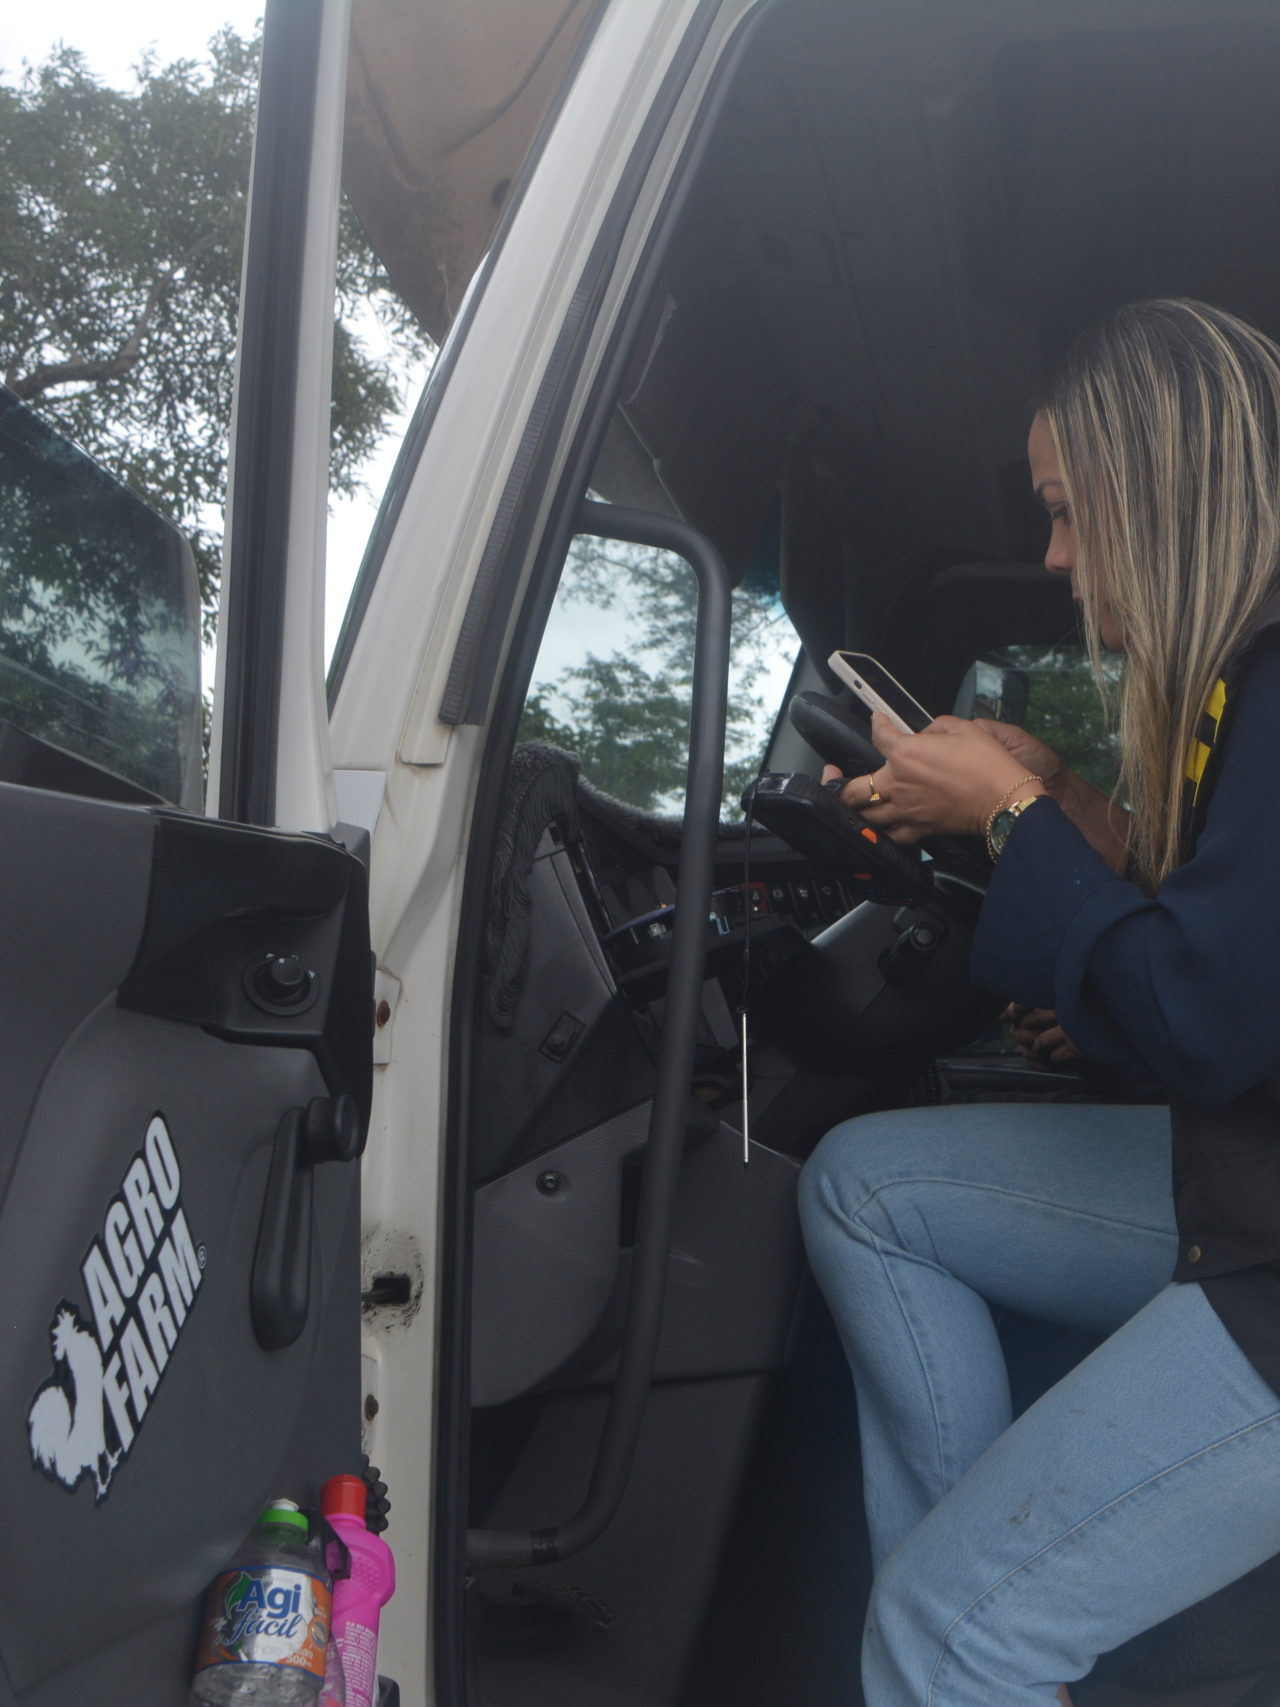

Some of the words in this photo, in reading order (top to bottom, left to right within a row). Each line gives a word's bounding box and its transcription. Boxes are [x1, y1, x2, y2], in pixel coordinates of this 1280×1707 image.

[82, 1116, 181, 1352] AGRO
[101, 1207, 202, 1454] FARM
[237, 1579, 302, 1618] Agi
